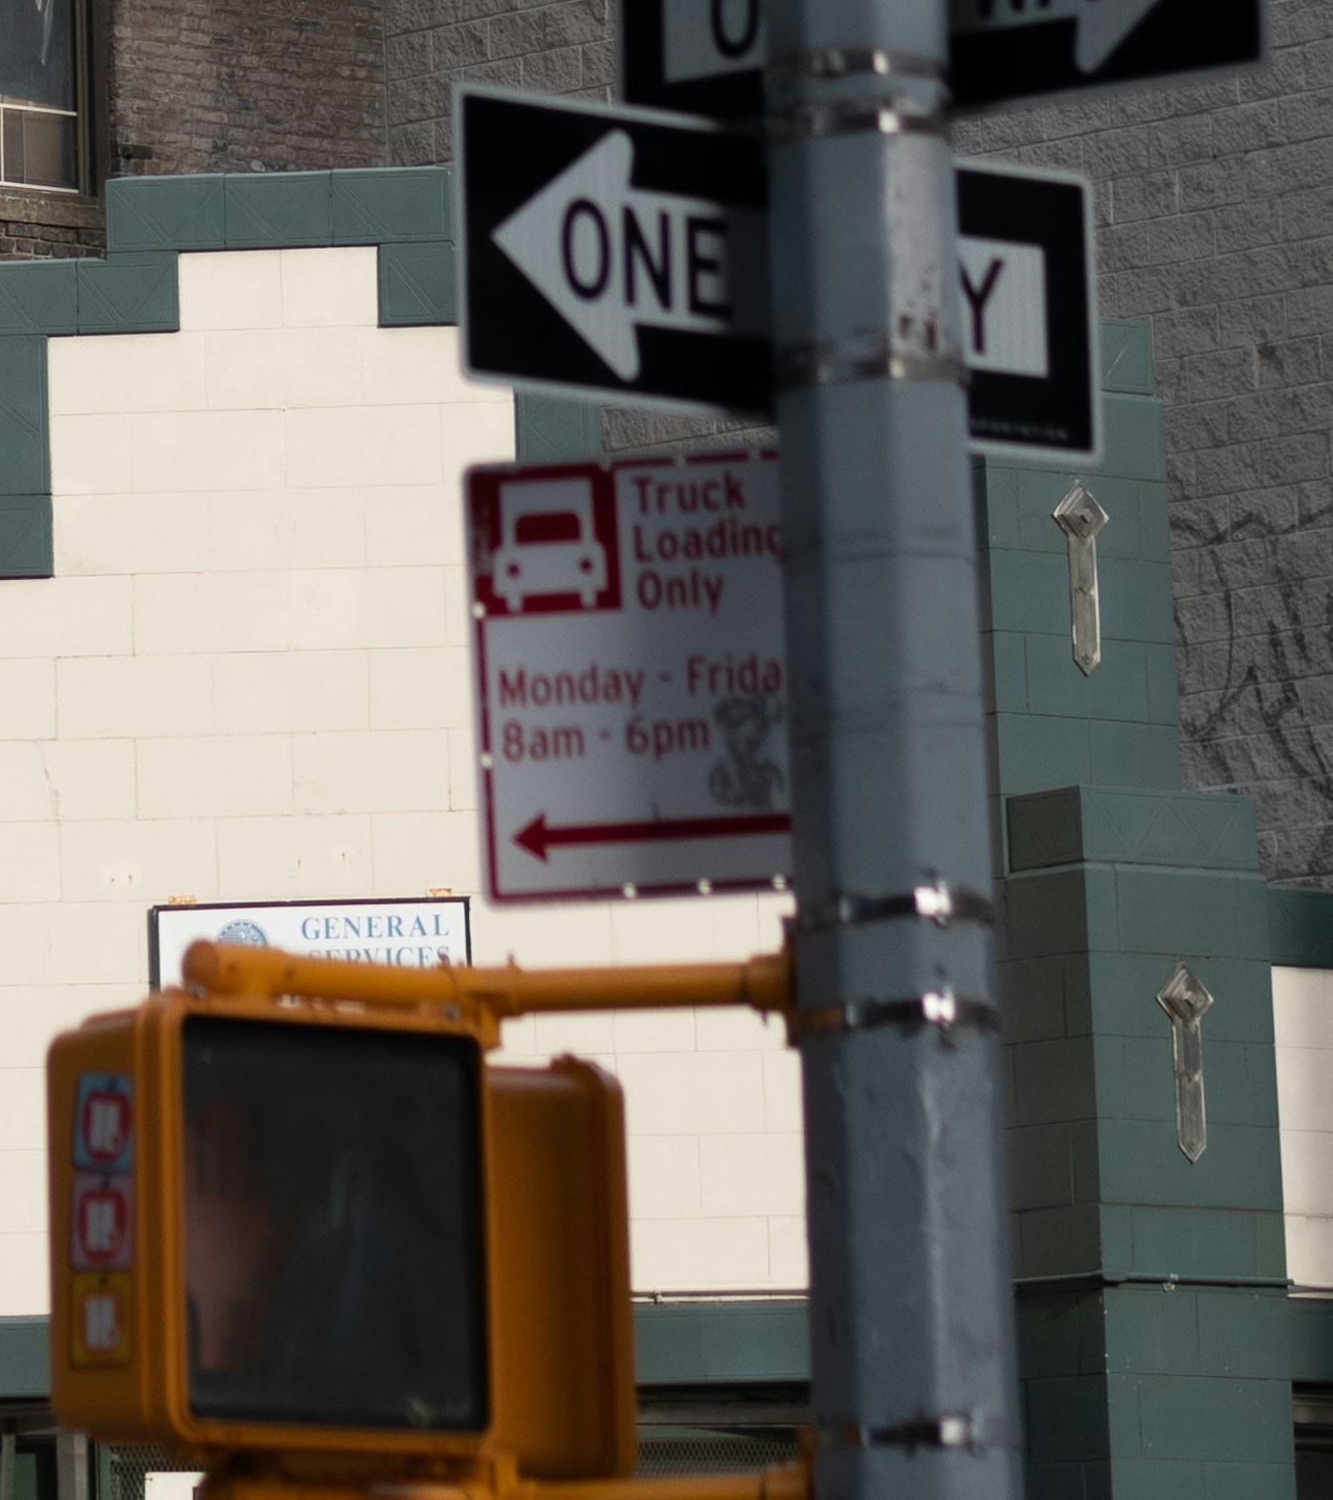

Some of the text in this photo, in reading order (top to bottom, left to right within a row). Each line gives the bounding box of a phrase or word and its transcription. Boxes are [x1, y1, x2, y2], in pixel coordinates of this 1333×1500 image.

[561, 198, 730, 324] ONE
[631, 473, 746, 517] Truck
[636, 570, 725, 615] Only
[498, 662, 646, 710] Monday
[686, 653, 782, 695] Frida
[501, 722, 585, 762] 8am
[626, 717, 711, 761] 6pm
[301, 913, 450, 940] GENERAL
